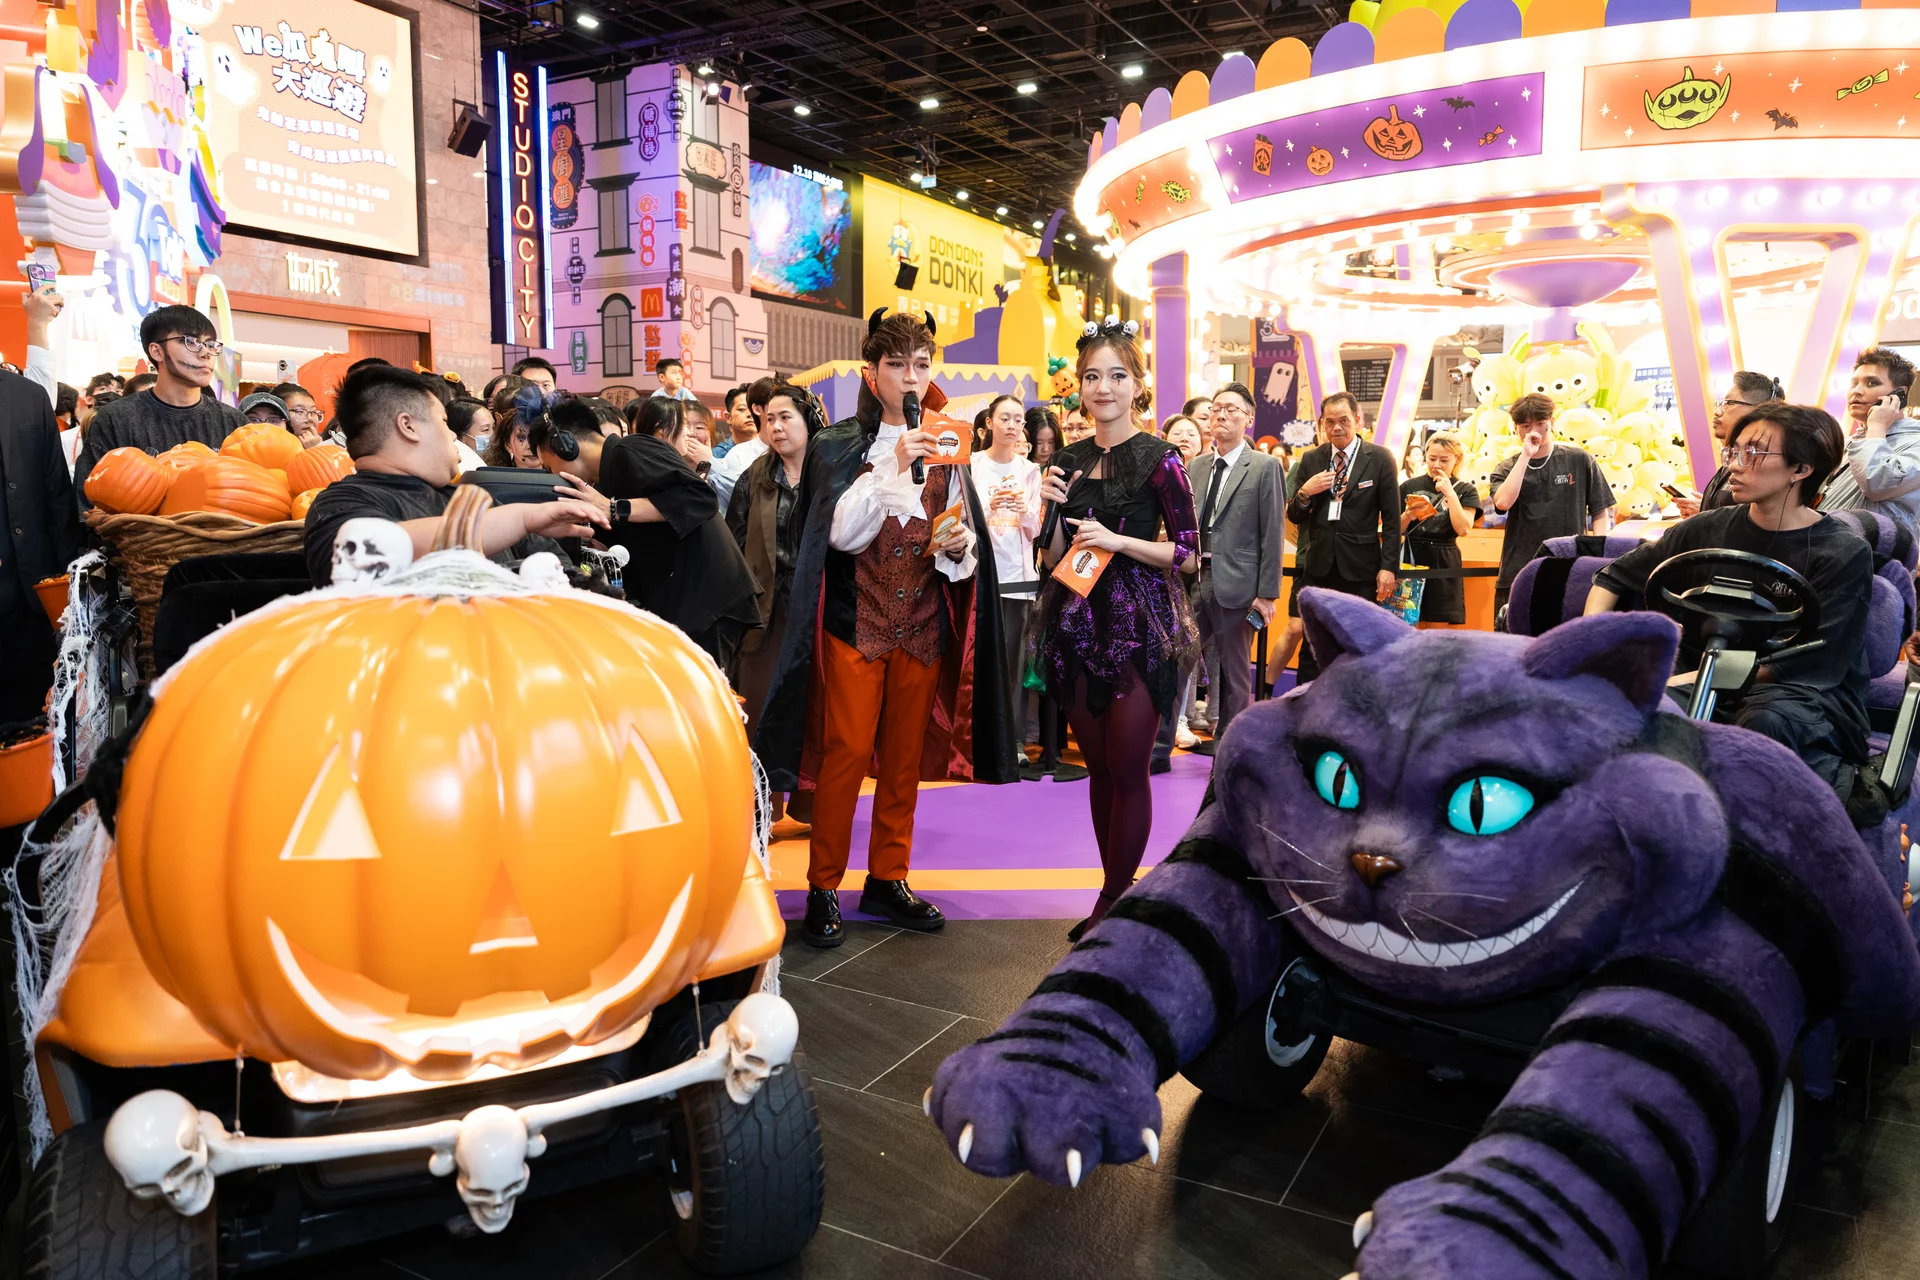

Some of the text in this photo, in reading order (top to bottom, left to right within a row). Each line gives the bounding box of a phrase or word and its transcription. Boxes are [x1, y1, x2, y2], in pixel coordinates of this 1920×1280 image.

[272, 62, 367, 123] 大巡遊
[513, 72, 536, 338] STUDIO CITY
[929, 235, 979, 267] DON DON
[929, 256, 984, 297] DONKI
